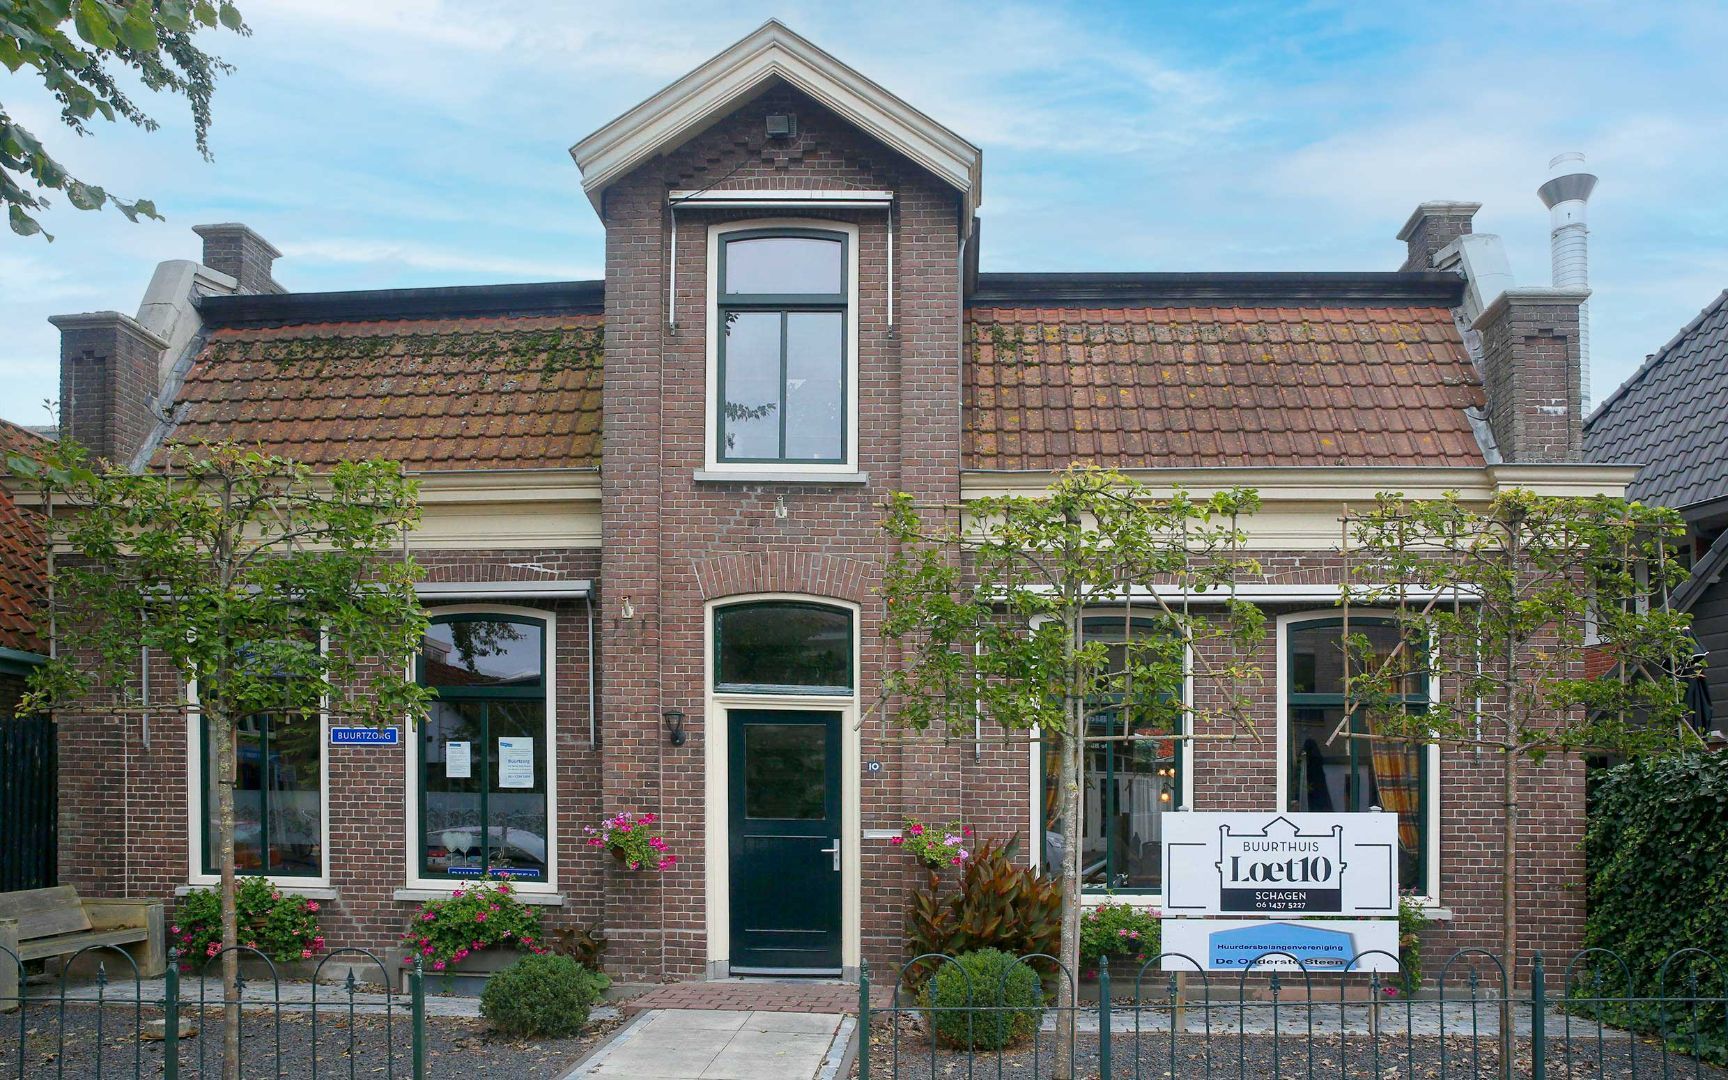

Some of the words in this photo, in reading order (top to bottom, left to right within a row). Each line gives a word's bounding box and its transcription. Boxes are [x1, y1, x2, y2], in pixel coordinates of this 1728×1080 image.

[868, 762, 880, 771] 10
[1243, 841, 1319, 852] BUURTHUIS
[1230, 856, 1332, 882] Loet10
[1255, 891, 1307, 900] SCHAGEN
[1304, 958, 1344, 966] Steen
